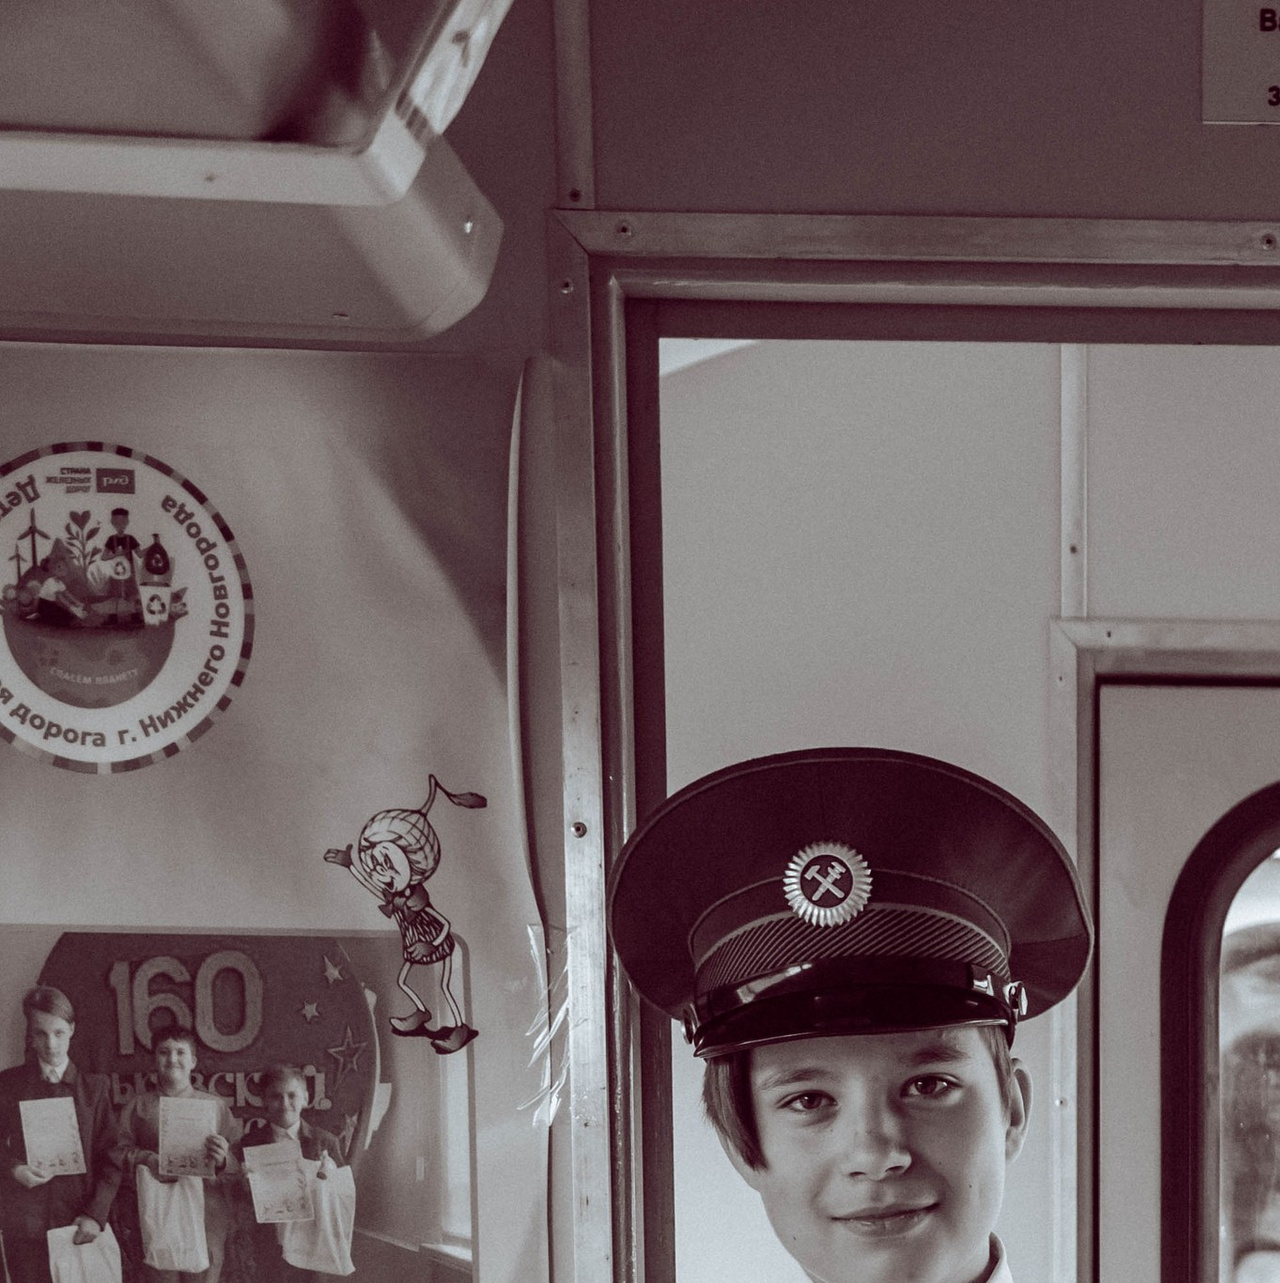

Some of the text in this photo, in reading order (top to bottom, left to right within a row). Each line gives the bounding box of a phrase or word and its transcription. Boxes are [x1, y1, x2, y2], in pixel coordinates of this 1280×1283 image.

[161, 494, 231, 639] Новгорода
[9, 702, 107, 747] дорога
[117, 729, 137, 746] г.
[138, 643, 226, 738] Нижнего
[108, 950, 264, 1056] 160
